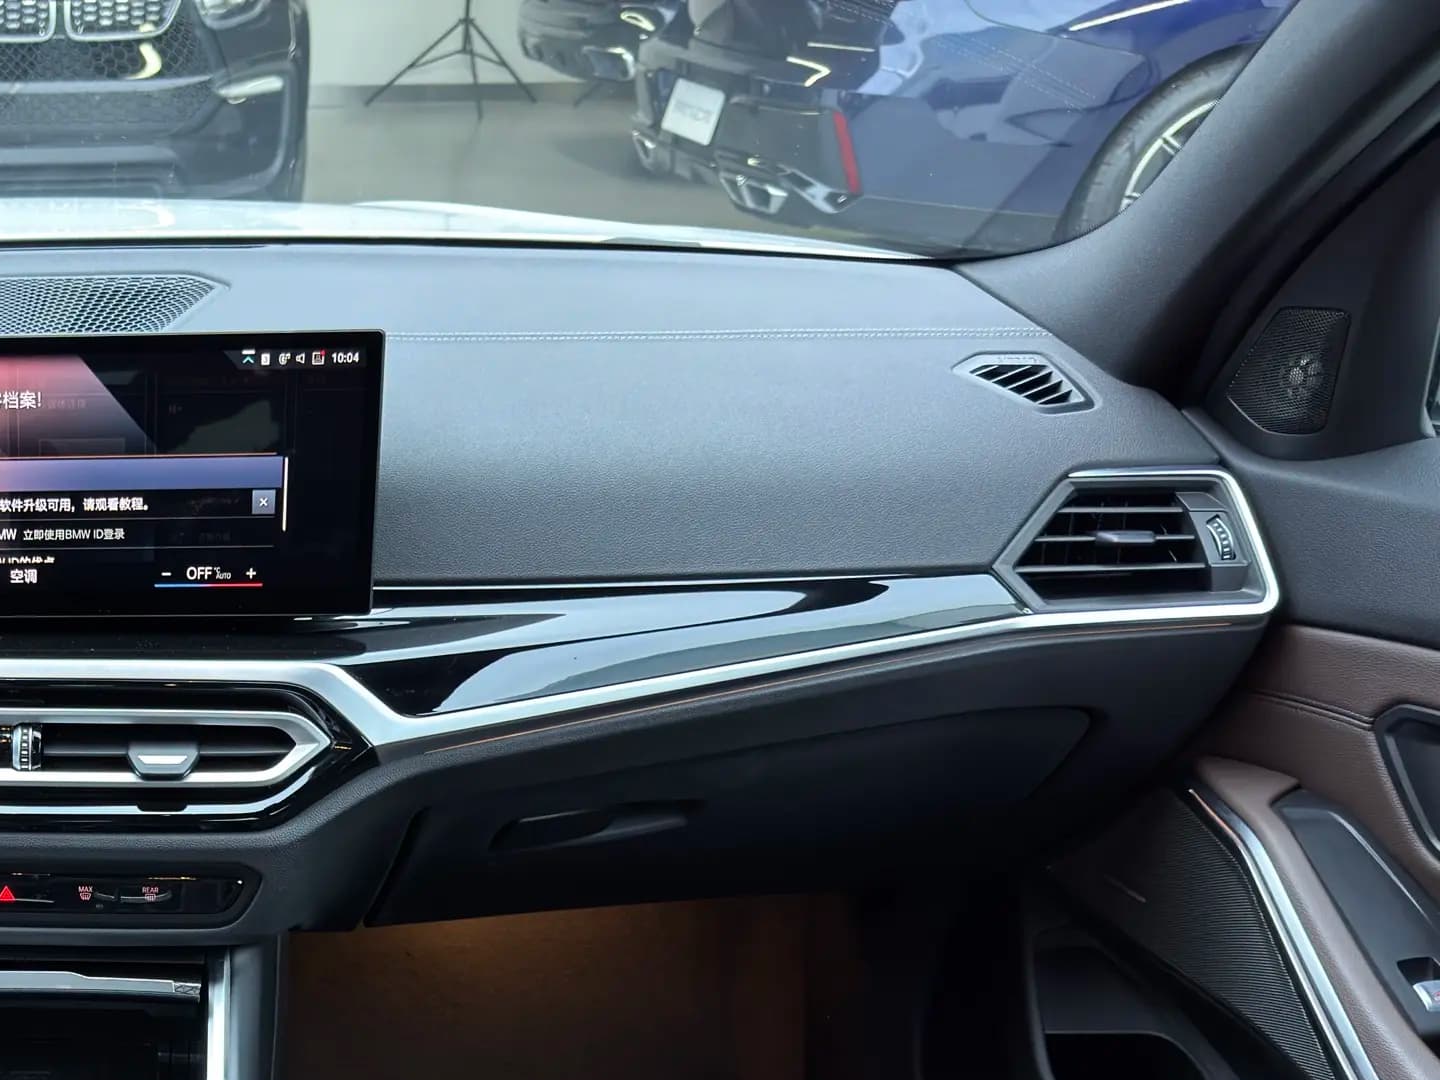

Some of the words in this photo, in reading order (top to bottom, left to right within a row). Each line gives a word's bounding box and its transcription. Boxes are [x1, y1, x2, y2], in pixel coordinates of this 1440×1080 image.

[331, 352, 359, 363] 10:04
[10, 569, 38, 584] 空调
[186, 566, 212, 580] OFF
